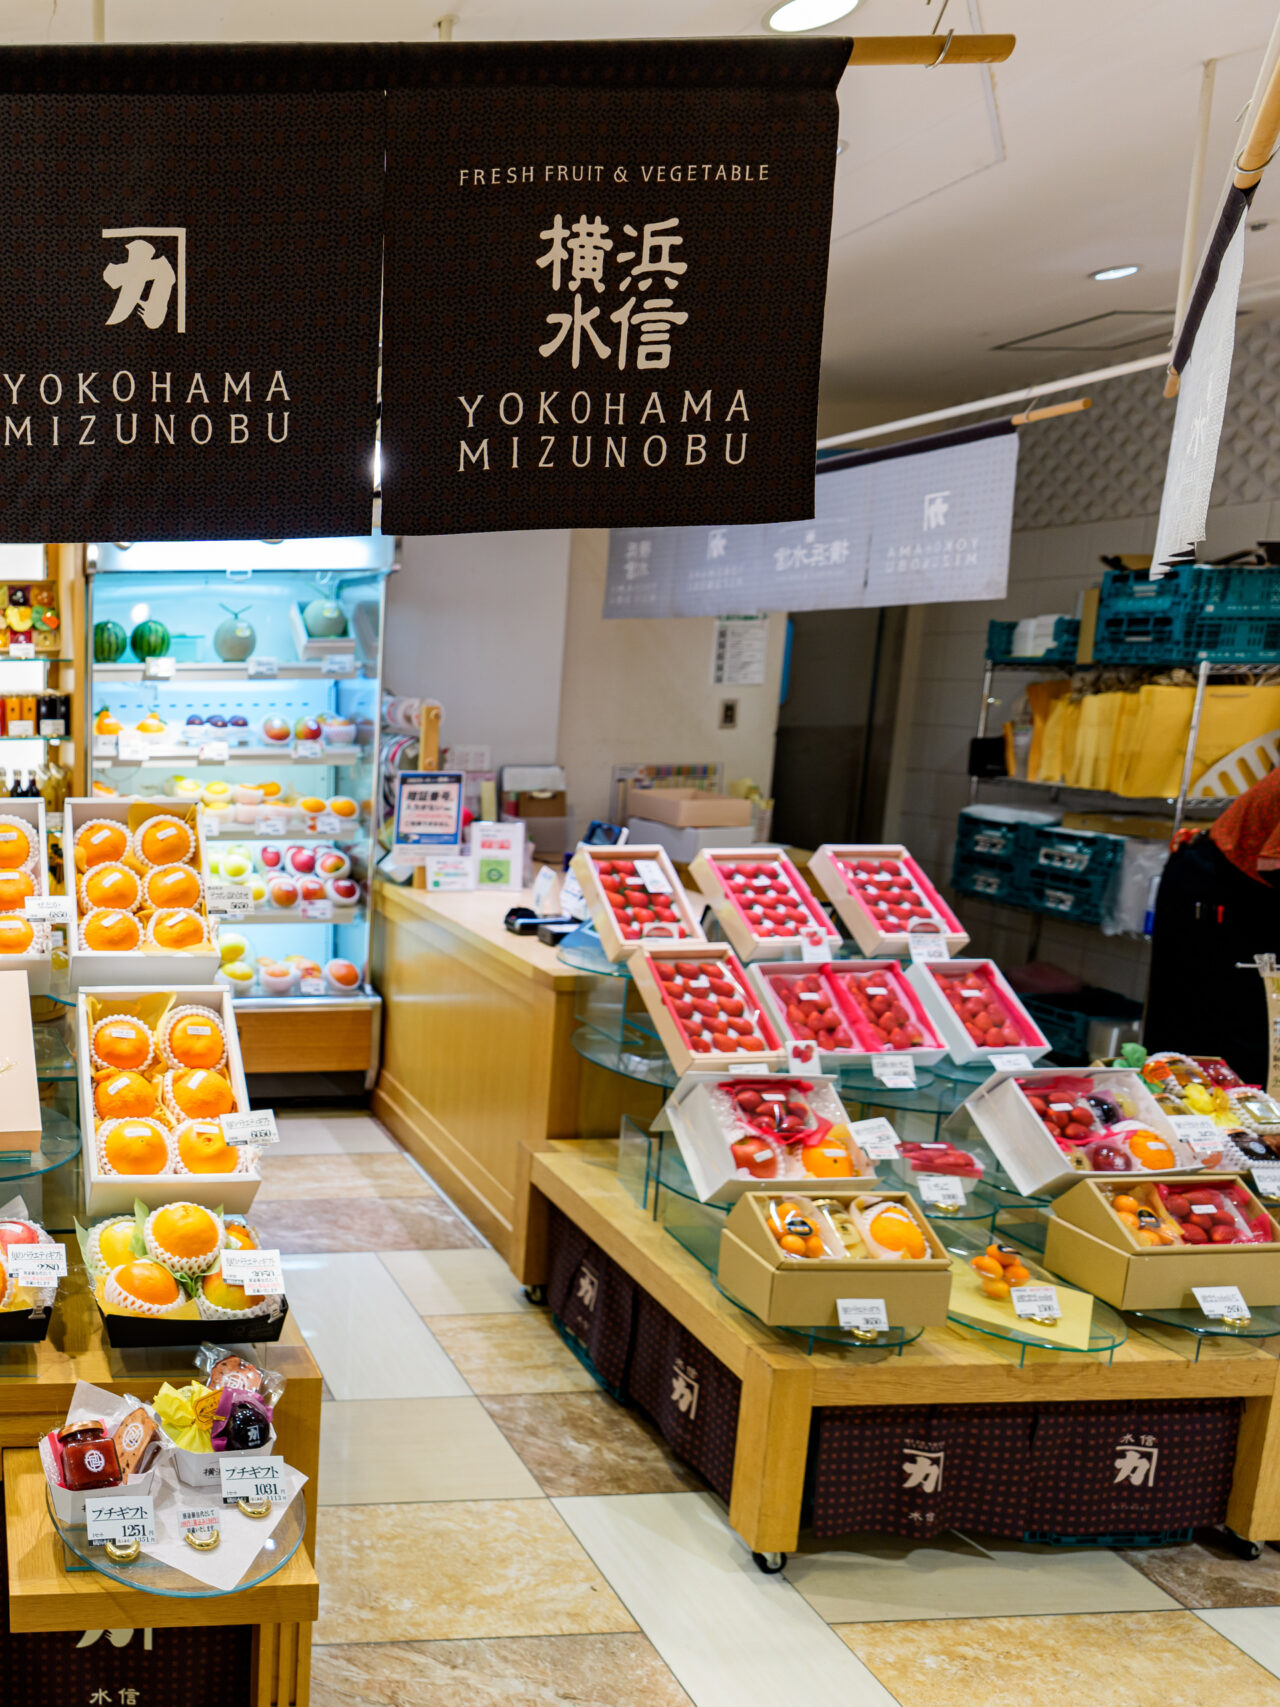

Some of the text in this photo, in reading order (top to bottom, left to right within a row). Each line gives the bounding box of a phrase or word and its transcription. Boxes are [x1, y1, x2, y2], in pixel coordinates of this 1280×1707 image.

[459, 164, 770, 186] FRESH FRUIT & VEGETABLE
[535, 213, 689, 294] 横浜
[538, 293, 689, 371] 水信
[3, 370, 291, 405] YOKOHAMA
[457, 389, 750, 428] YOKOHAMA
[3, 412, 290, 446] MIZUNOBU
[457, 433, 748, 472] MIZUNOBU
[225, 1465, 280, 1479] プチギフト
[254, 1483, 279, 1496] 1031
[91, 1505, 149, 1520] プチギフト
[121, 1524, 147, 1537] 1251
[88, 1687, 141, 1705] 水信
